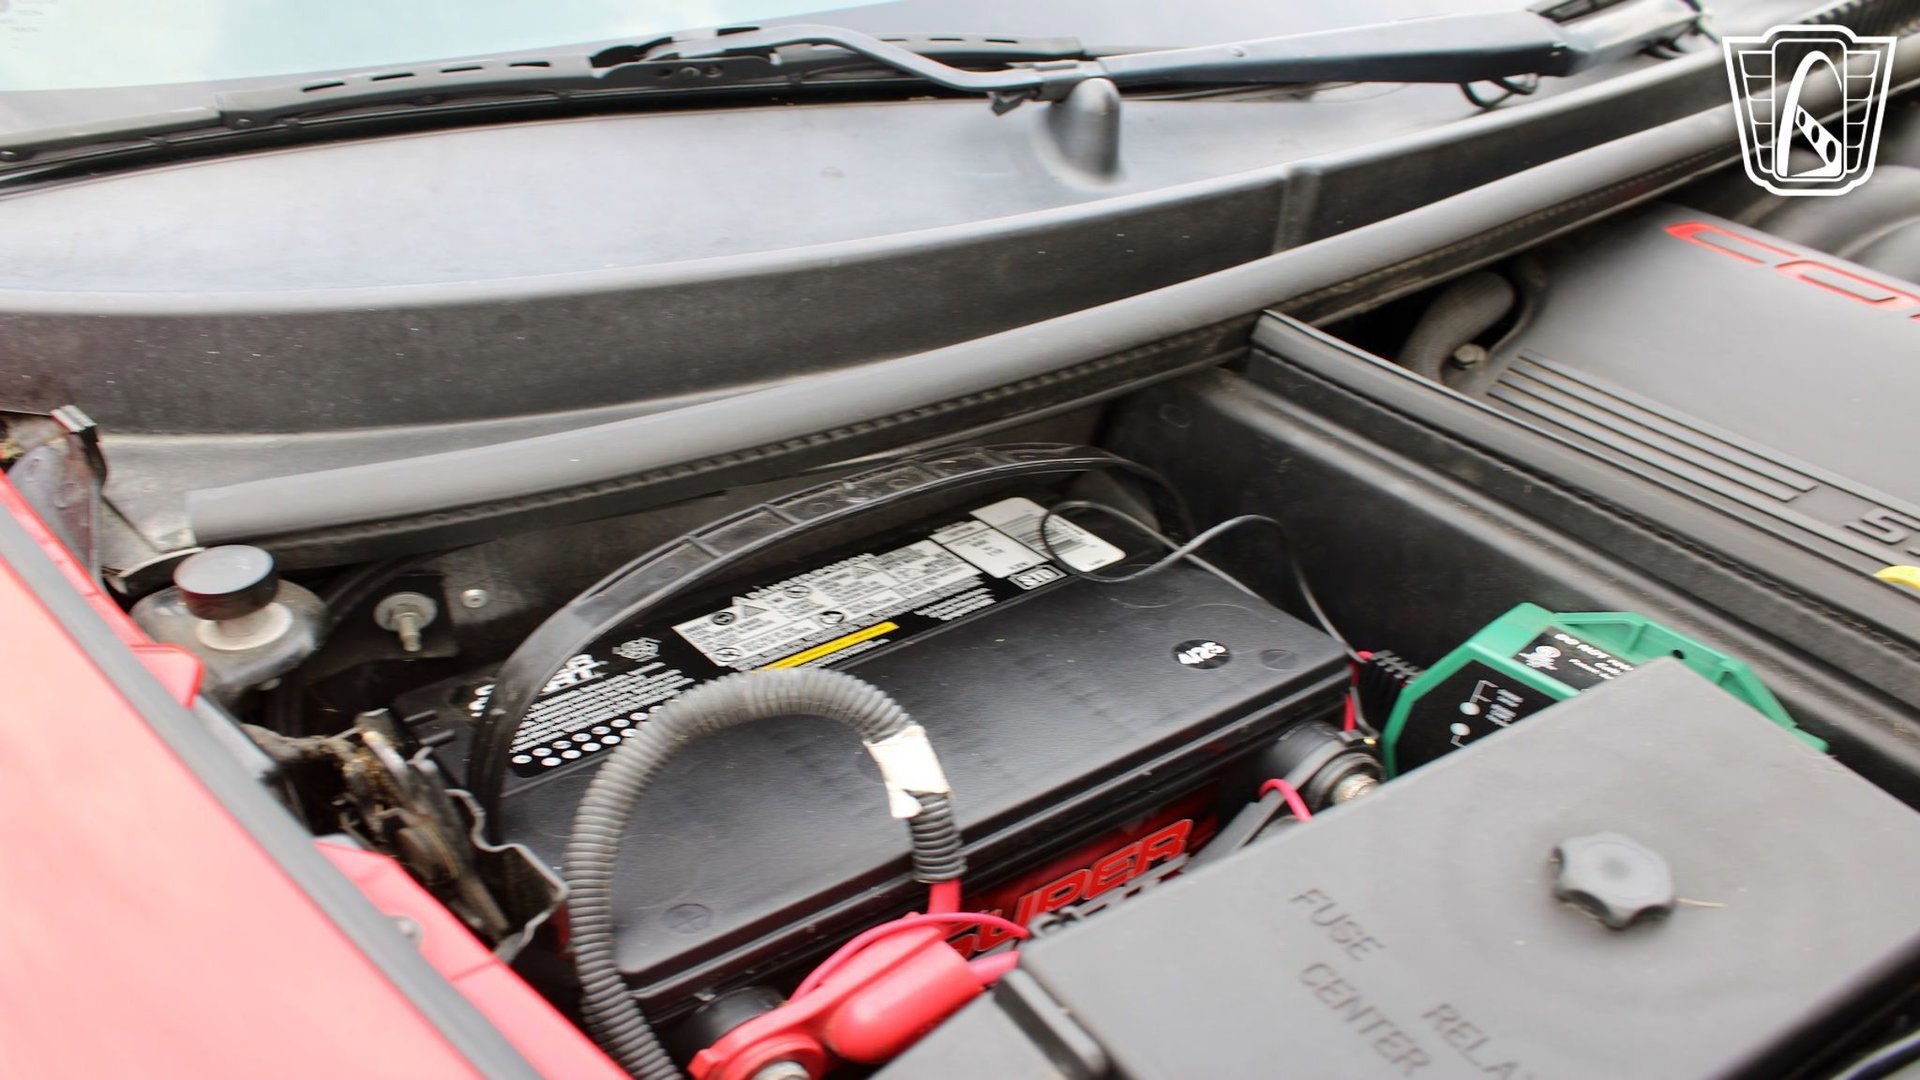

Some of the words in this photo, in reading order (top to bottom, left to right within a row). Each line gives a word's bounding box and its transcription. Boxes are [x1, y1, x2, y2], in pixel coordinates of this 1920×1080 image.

[1664, 221, 1920, 323] CO
[1289, 888, 1386, 961] FUSE
[1421, 1003, 1535, 1080] RELA
[1299, 963, 1431, 1077] CENTER
